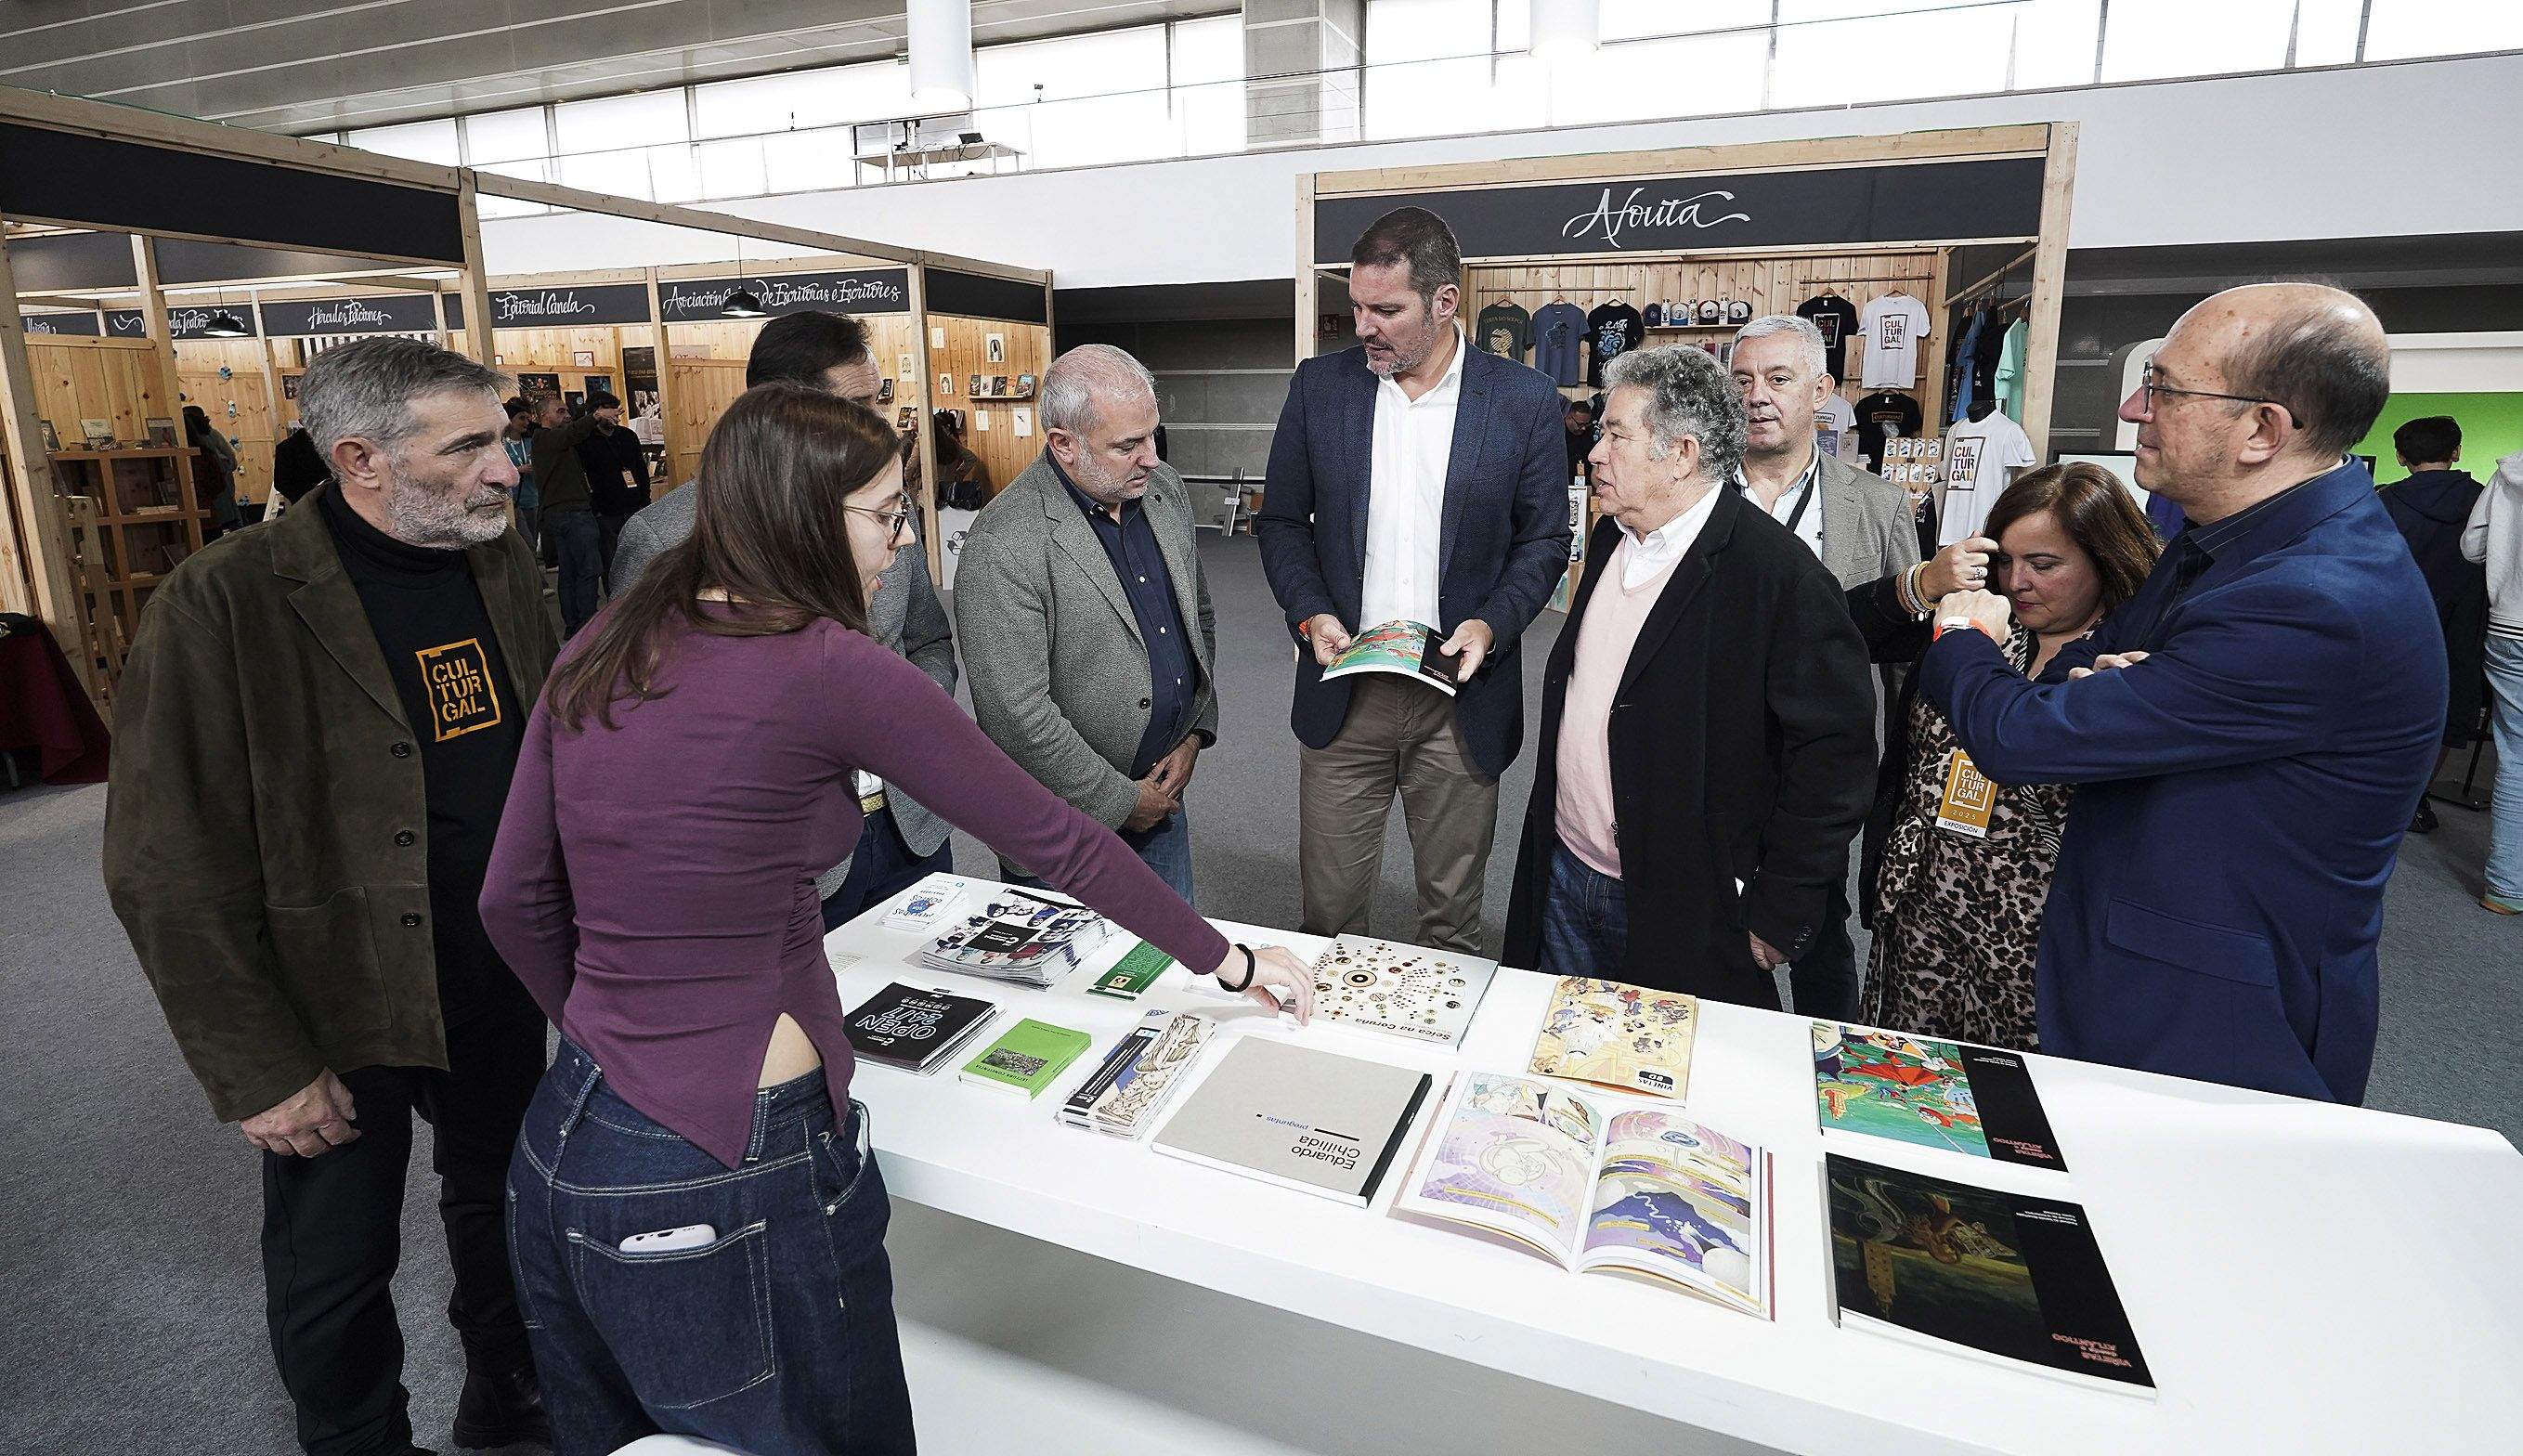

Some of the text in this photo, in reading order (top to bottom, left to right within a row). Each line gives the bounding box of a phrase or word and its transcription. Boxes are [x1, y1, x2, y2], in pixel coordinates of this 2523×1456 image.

[663, 285, 723, 317] Asociación
[773, 282, 829, 306] Escritoras
[837, 279, 901, 303] Escritores
[495, 292, 595, 320] Editorial Canela
[1884, 319, 1903, 329] CUL
[1884, 328, 1903, 336] TUR
[1884, 335, 1901, 344] GAL
[1954, 446, 1975, 458] CUL
[1953, 458, 1975, 470] TUR
[1951, 470, 1972, 482] GAL
[432, 657, 478, 683] CUL
[436, 675, 483, 702] TUR
[441, 696, 486, 722] GAL
[1961, 768, 1985, 783] CUL
[1960, 778, 1985, 793] TUR
[1957, 787, 1981, 802] GAL
[1952, 809, 1977, 820] 2025
[881, 1007, 943, 1025] 24/7
[854, 1014, 937, 1040] OPEN
[1266, 1116, 1309, 1130] preguntas
[1298, 1135, 1360, 1158] Chillida
[1291, 1146, 1357, 1170] Eduardo
